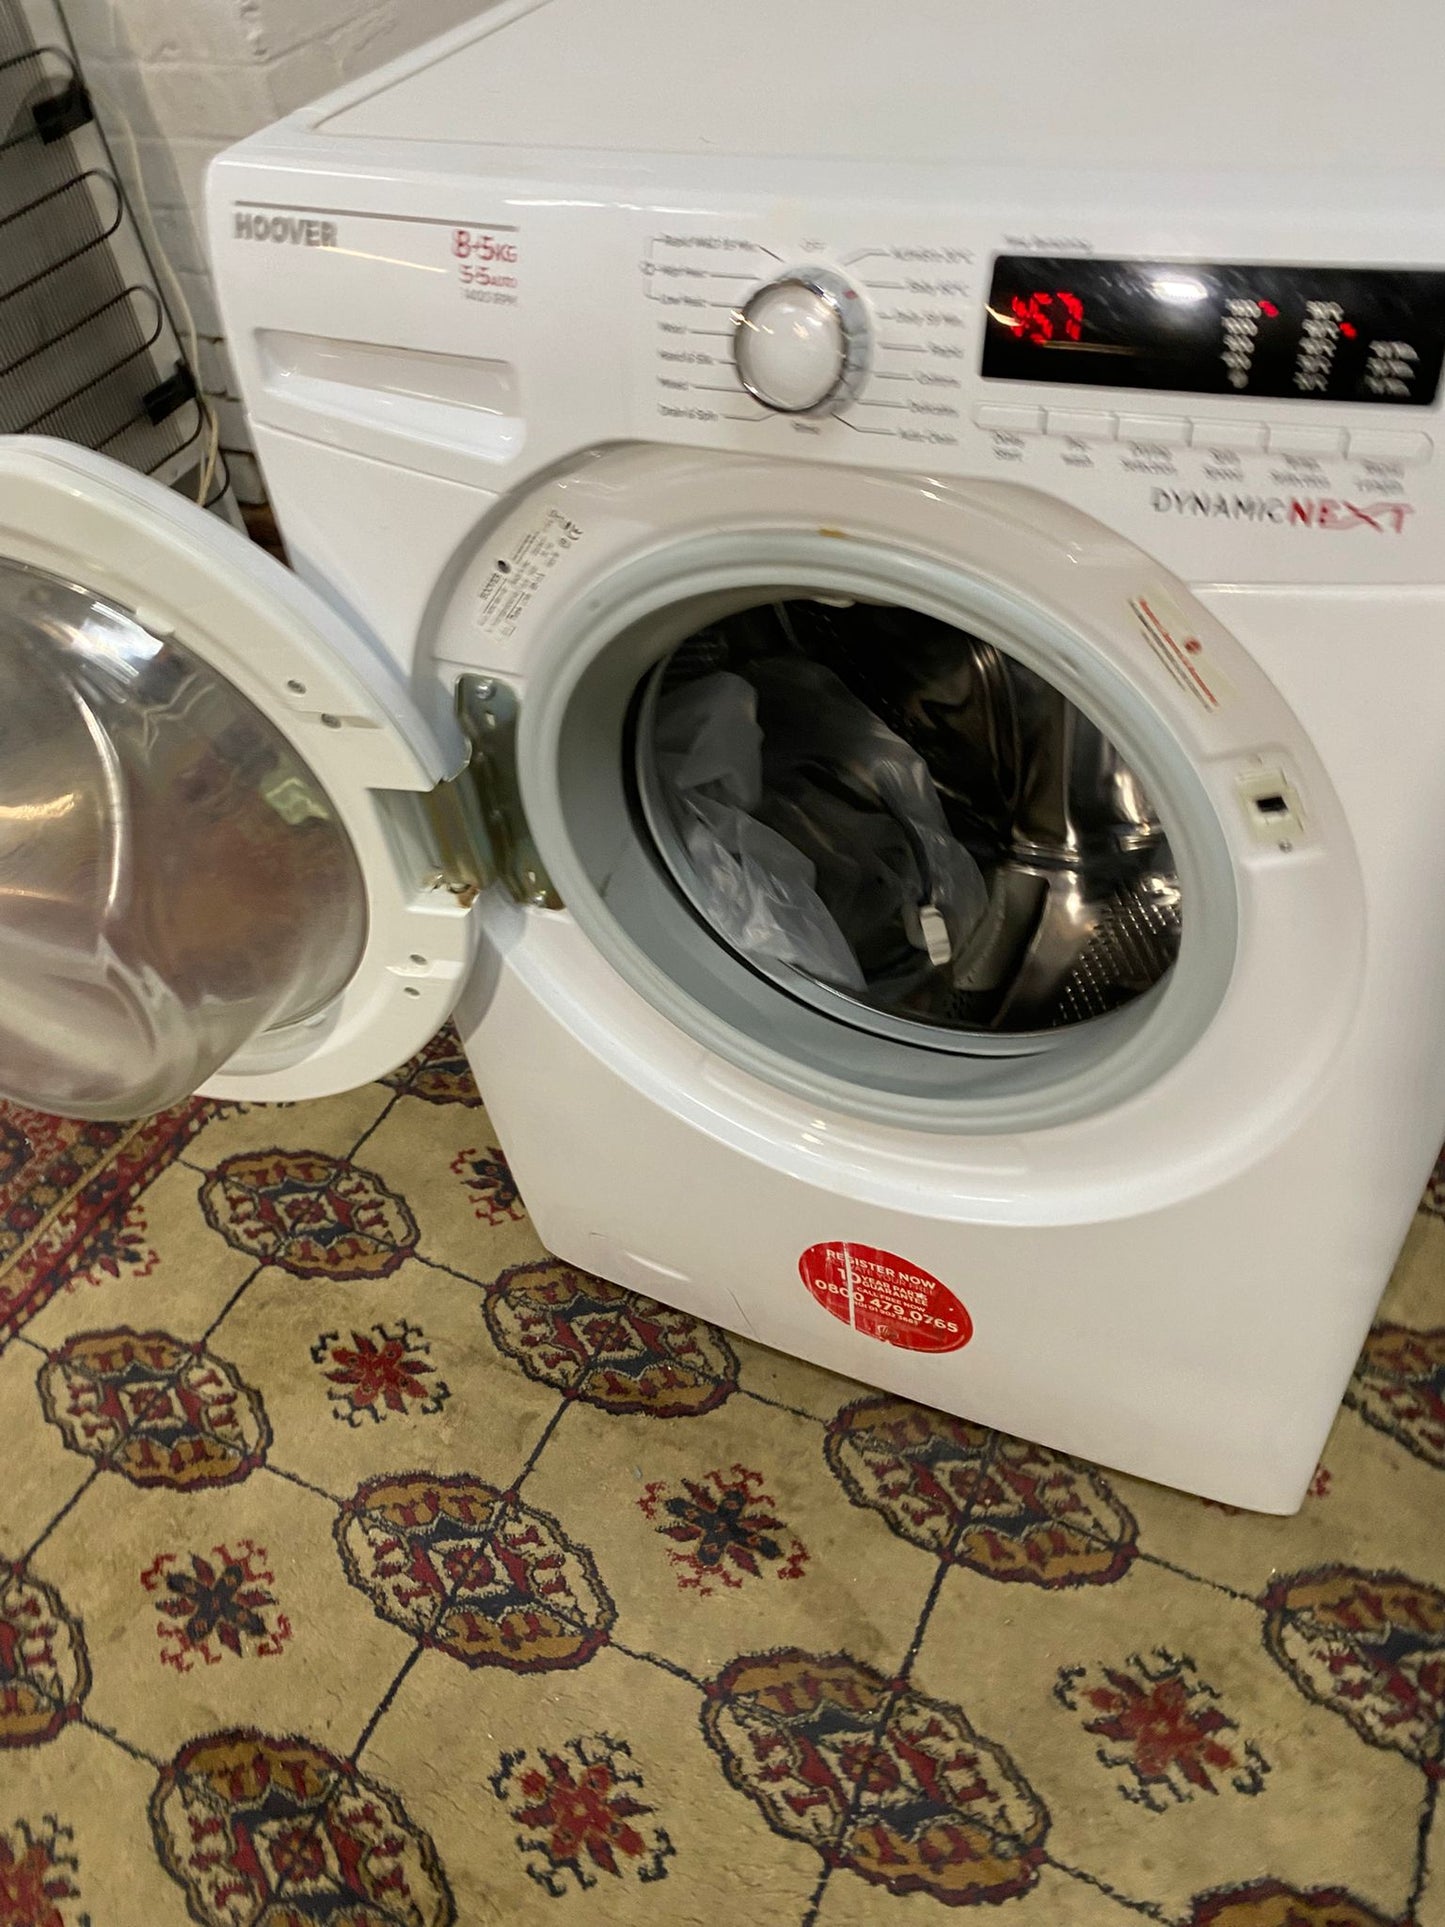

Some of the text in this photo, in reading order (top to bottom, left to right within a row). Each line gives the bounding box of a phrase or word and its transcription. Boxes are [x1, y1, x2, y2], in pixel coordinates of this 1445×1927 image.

[234, 212, 337, 247] HOOVER
[826, 1249, 936, 1289] REGISTER NOW
[837, 1268, 861, 1284] 10
[861, 1275, 890, 1288] YEAR
[814, 1279, 958, 1333] 0800 479 0765
[862, 1281, 928, 1307] GUARANTEE
[903, 1301, 925, 1312] NOW
